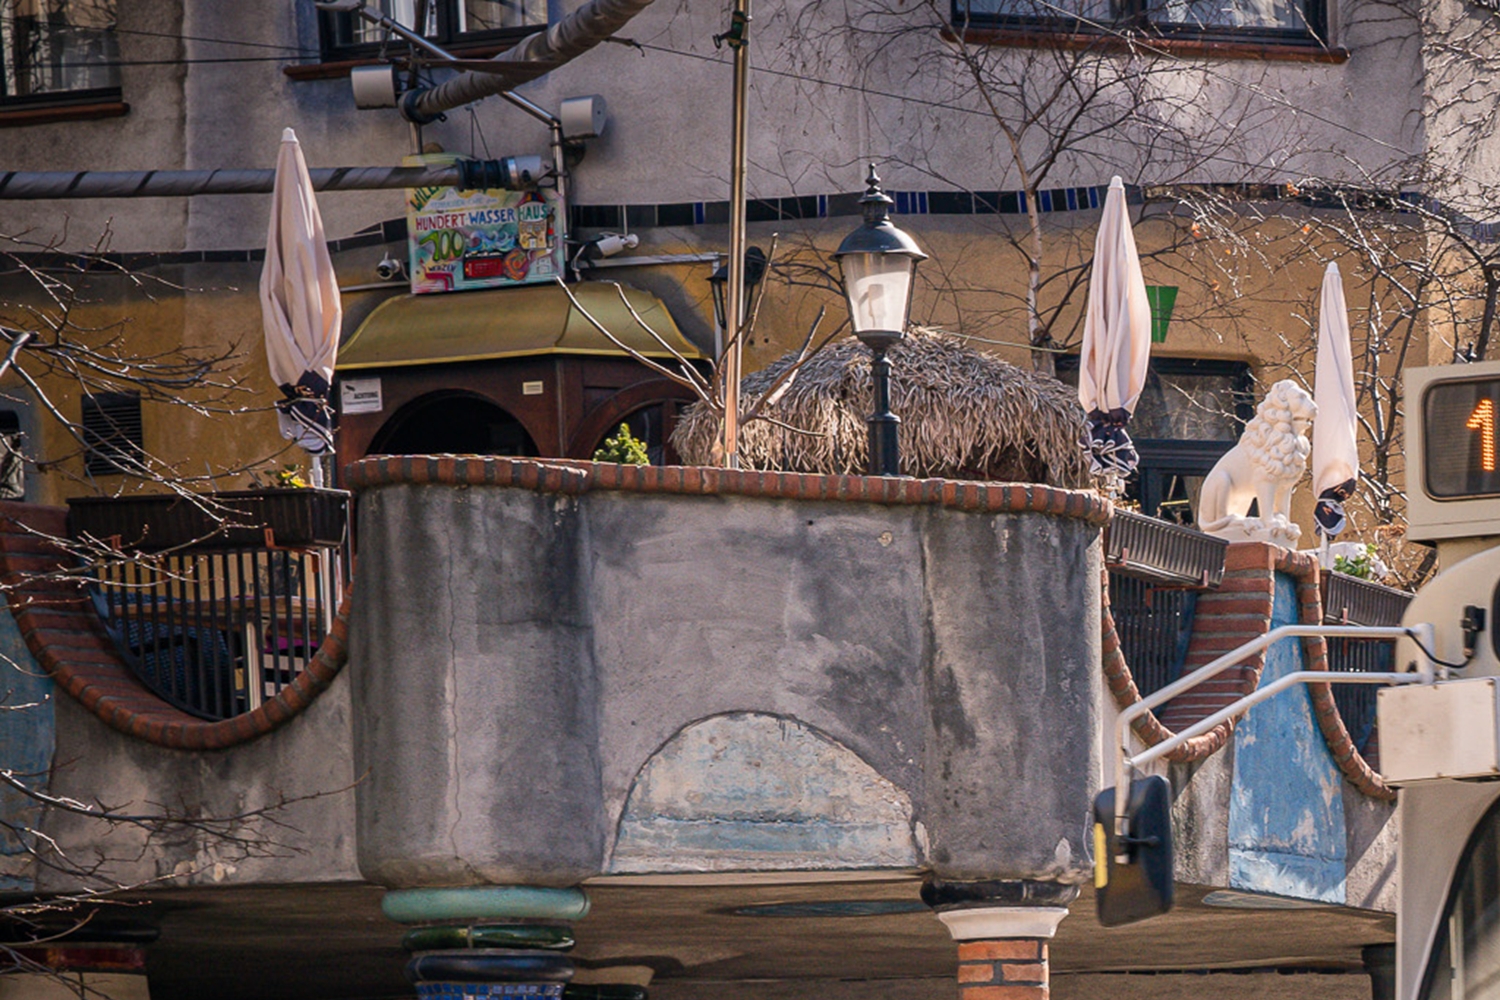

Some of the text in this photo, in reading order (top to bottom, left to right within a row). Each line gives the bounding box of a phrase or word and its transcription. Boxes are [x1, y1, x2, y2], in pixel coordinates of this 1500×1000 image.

[468, 208, 515, 225] WASSER
[519, 204, 548, 221] HAUS
[1466, 399, 1495, 472] 1
